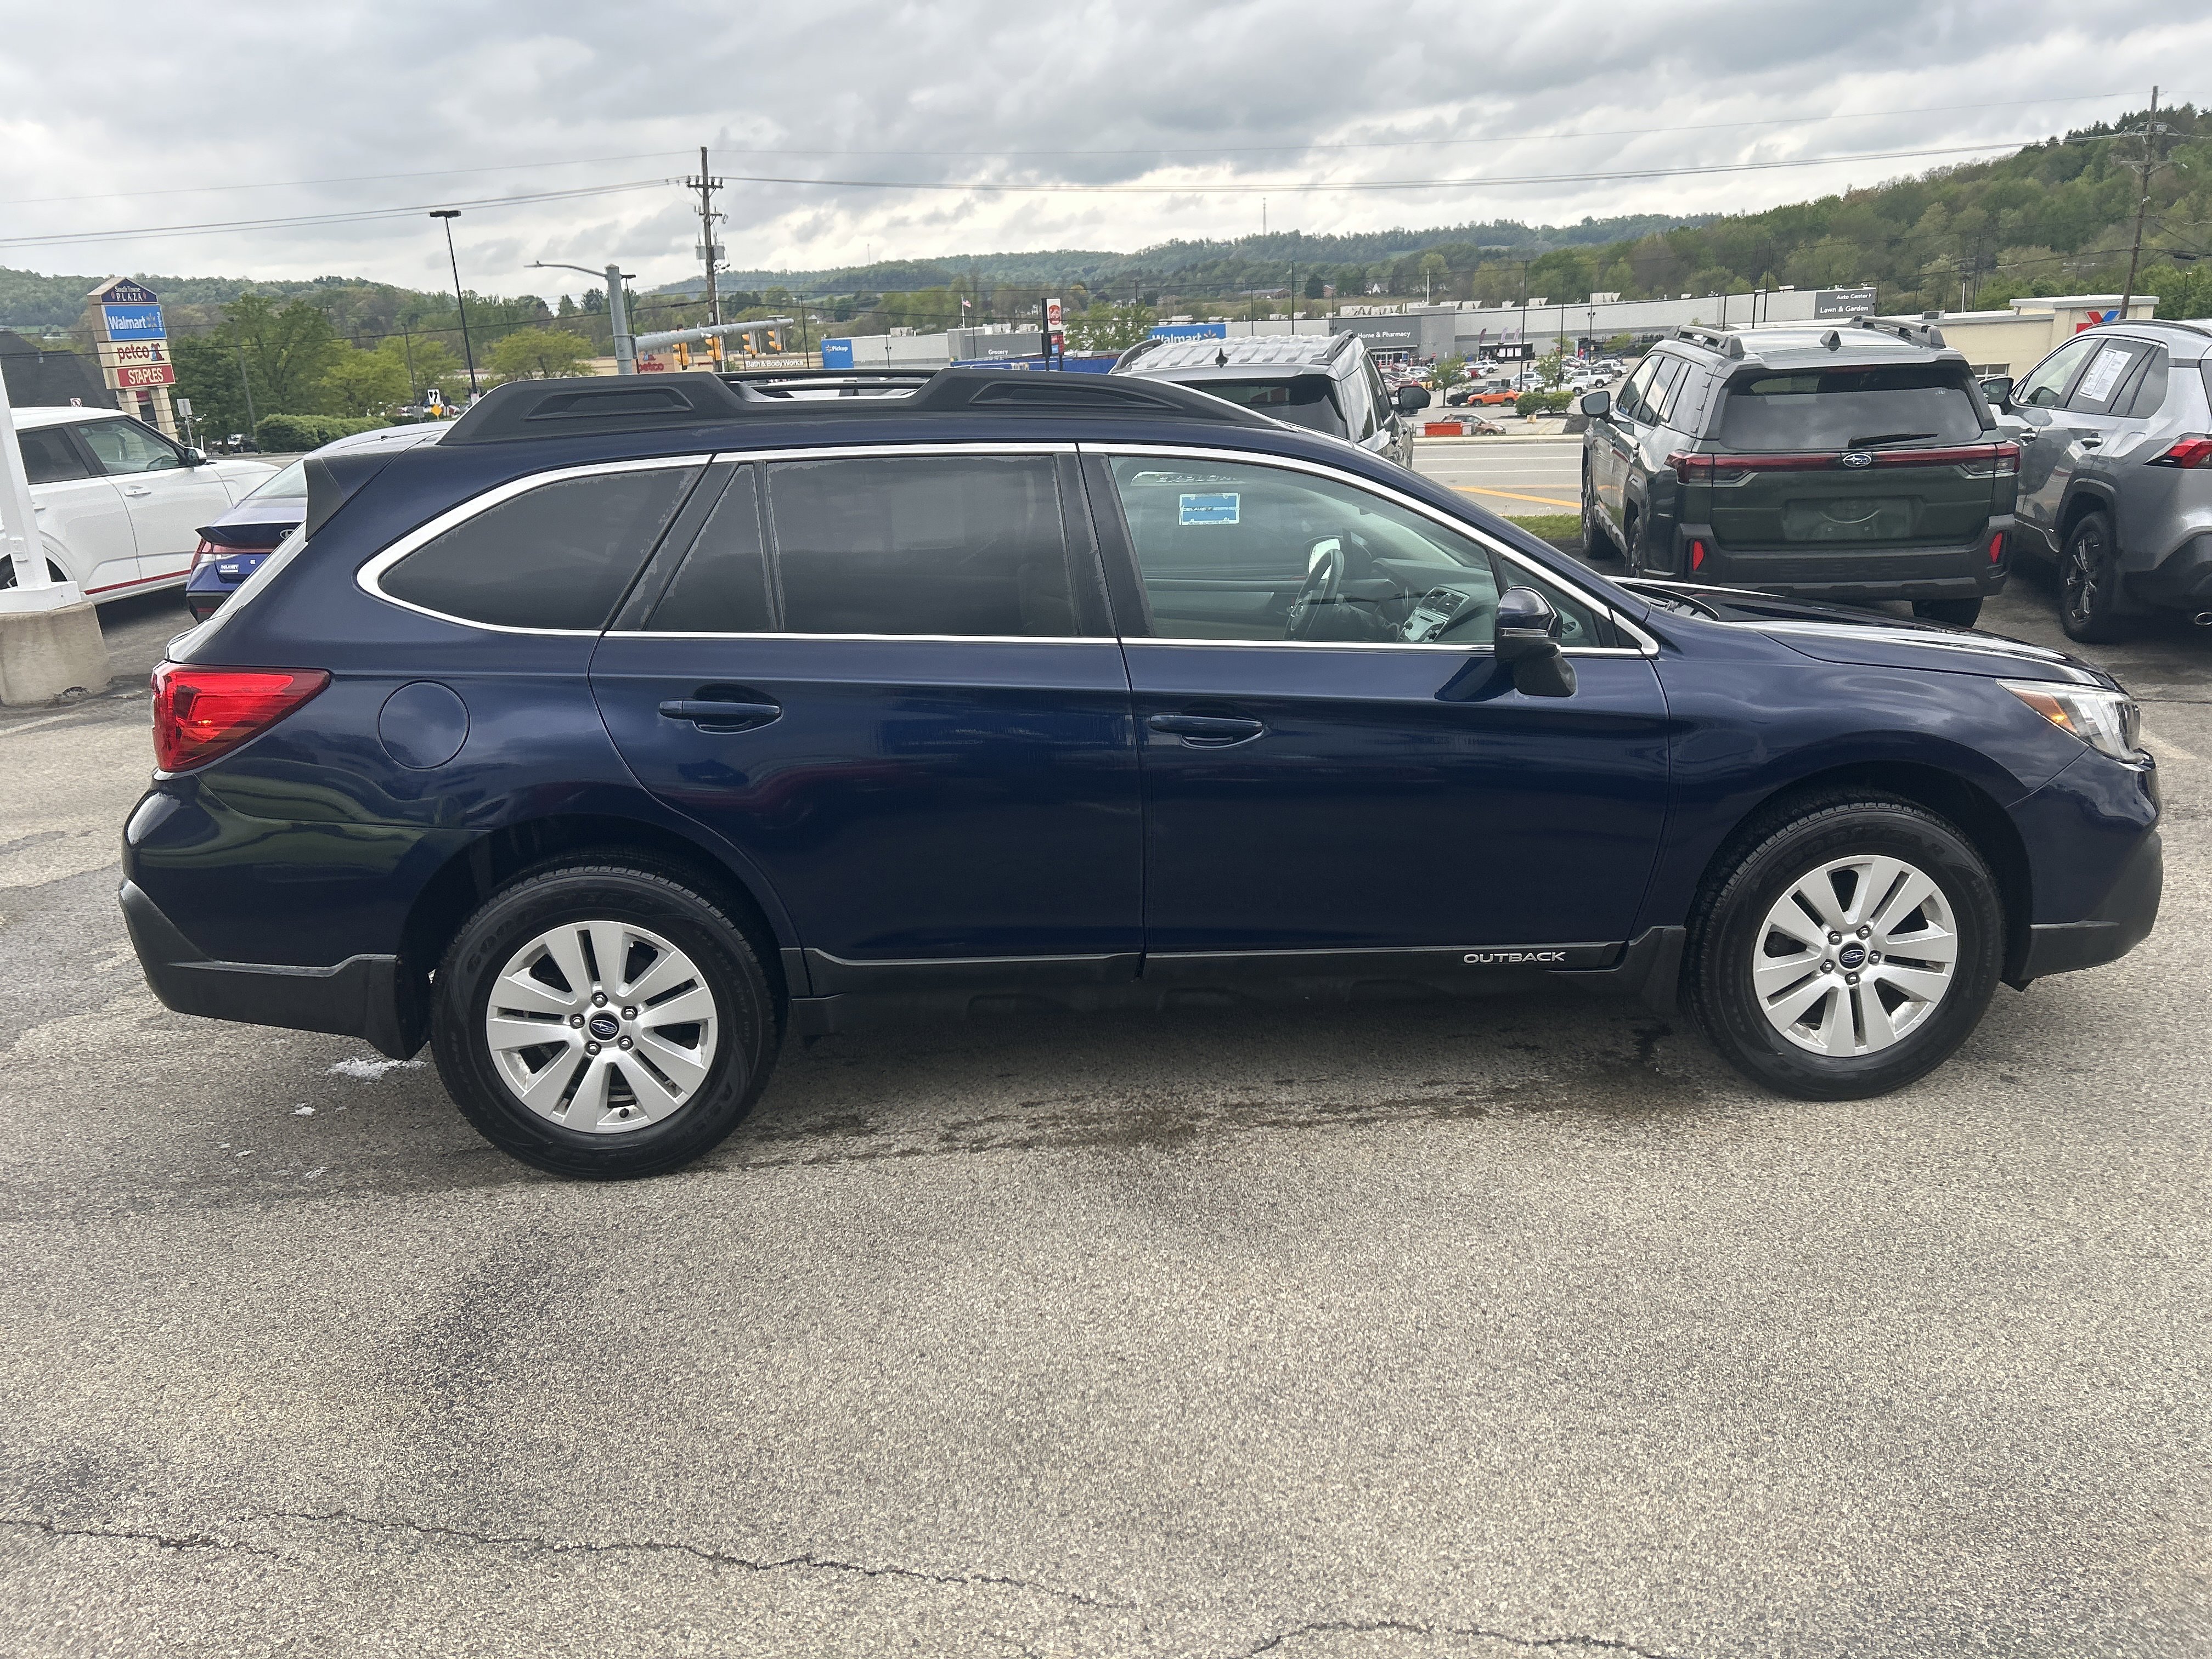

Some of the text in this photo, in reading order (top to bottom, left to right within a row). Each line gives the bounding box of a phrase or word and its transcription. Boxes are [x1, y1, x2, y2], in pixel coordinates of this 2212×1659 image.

[116, 292, 143, 301] PLAZA
[108, 315, 146, 330] Walmart
[1382, 330, 1411, 338] Pharmacy
[117, 344, 150, 363] petco
[832, 345, 848, 353] Pickup
[746, 360, 760, 368] Bath
[761, 359, 766, 368] &
[766, 359, 783, 369] Body
[128, 368, 164, 385] STAPLES
[1463, 952, 1566, 964] OUTBACK
